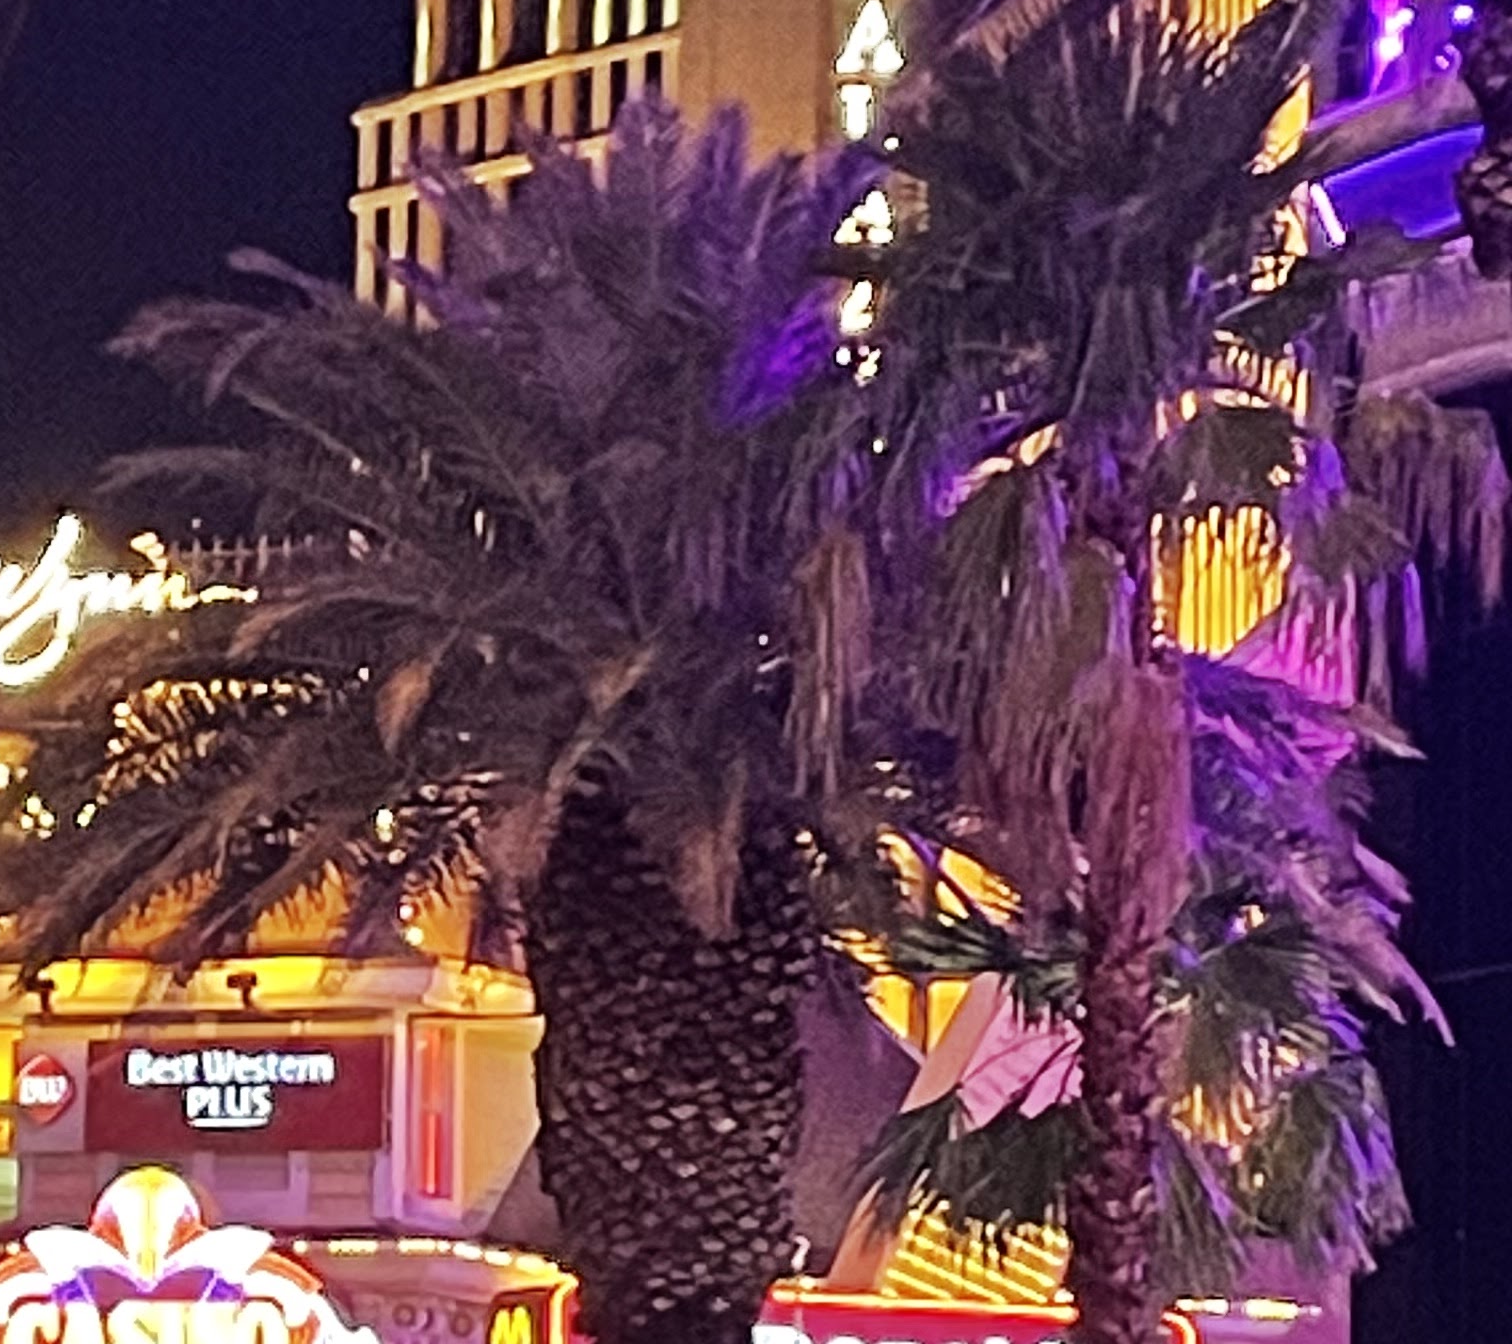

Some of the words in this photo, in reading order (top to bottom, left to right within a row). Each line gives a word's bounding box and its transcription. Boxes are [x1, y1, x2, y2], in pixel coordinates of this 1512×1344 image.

[127, 1048, 199, 1086] Best
[201, 1049, 335, 1085] Western
[186, 1084, 273, 1119] PLUS
